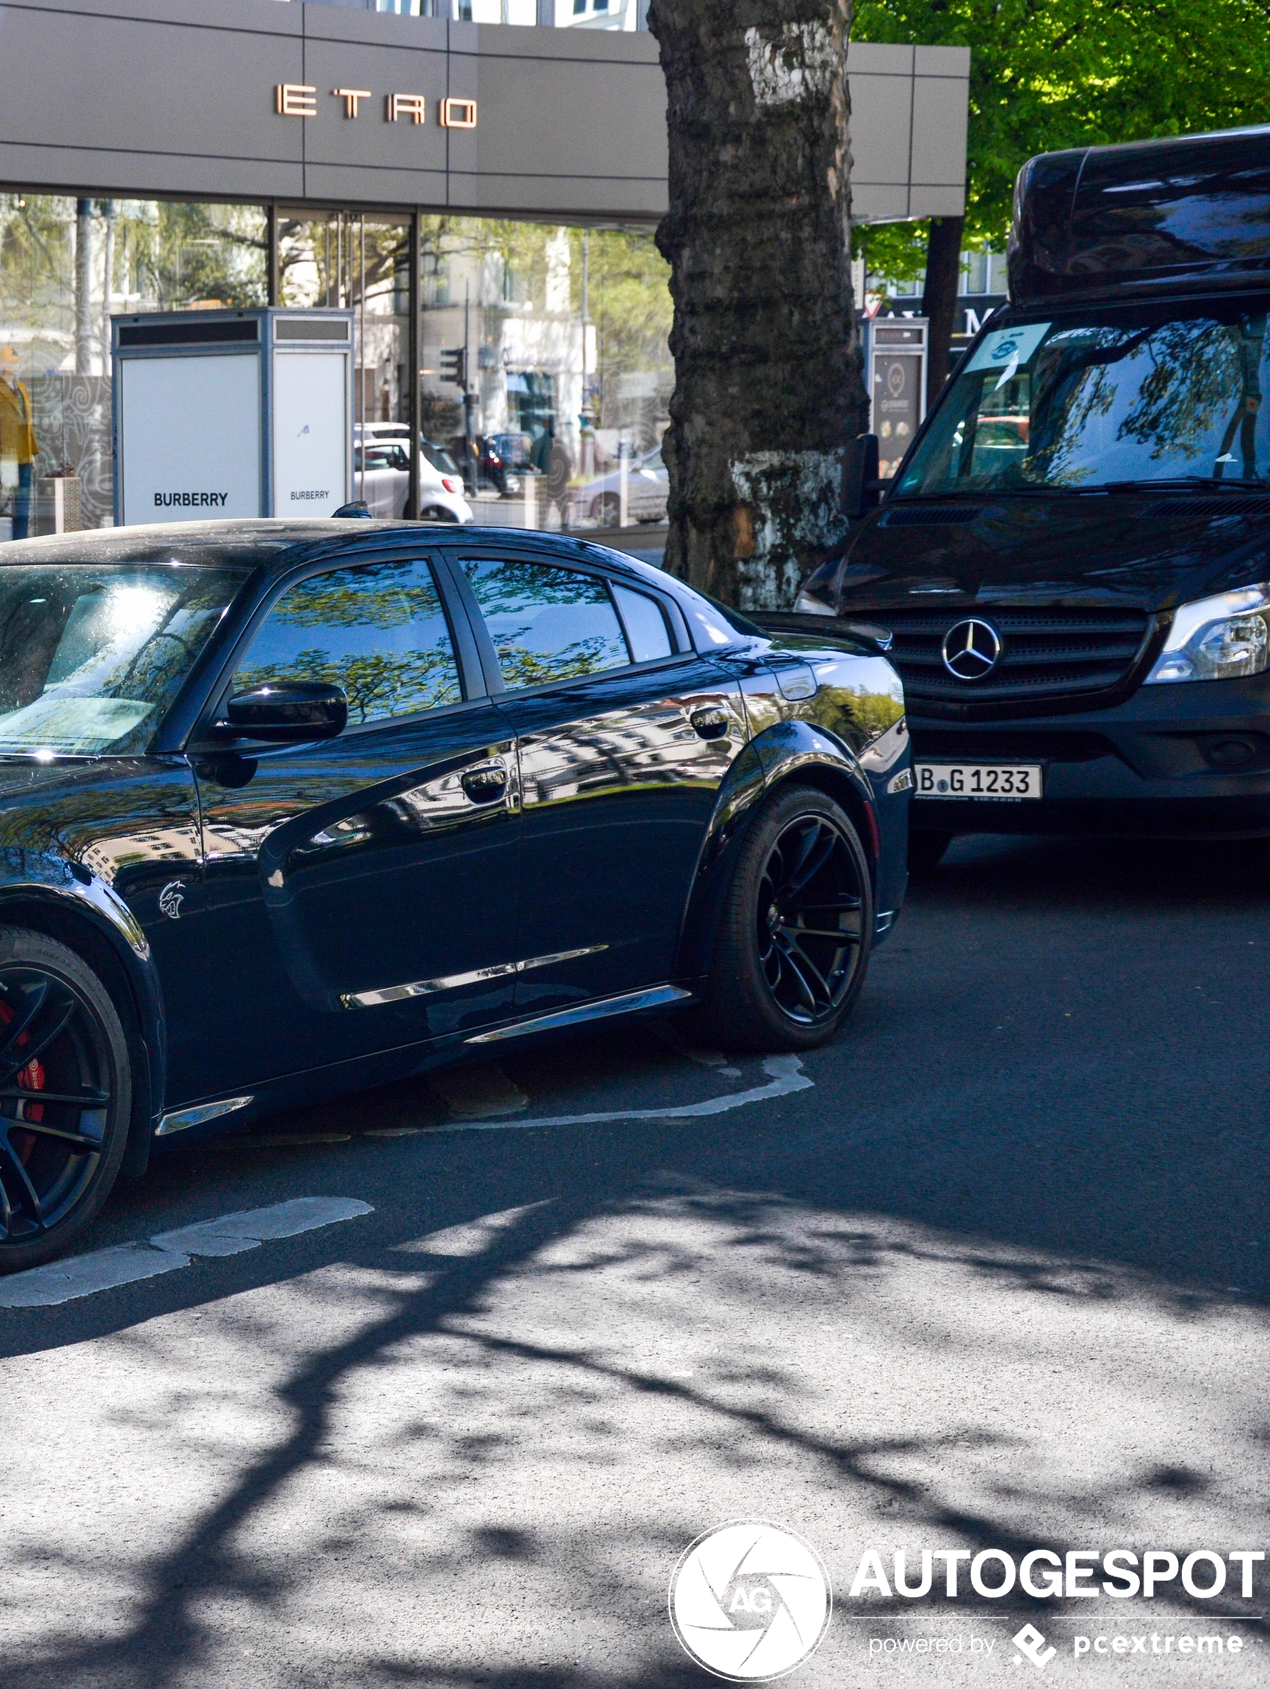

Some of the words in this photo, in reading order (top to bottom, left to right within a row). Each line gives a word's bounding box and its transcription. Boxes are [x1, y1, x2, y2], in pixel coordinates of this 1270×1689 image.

[277, 84, 477, 128] ETRO
[154, 492, 229, 507] BURBERRY
[290, 490, 330, 501] BURBERRY
[920, 768, 935, 792] B
[950, 769, 965, 792] G
[971, 769, 1030, 794] 1233
